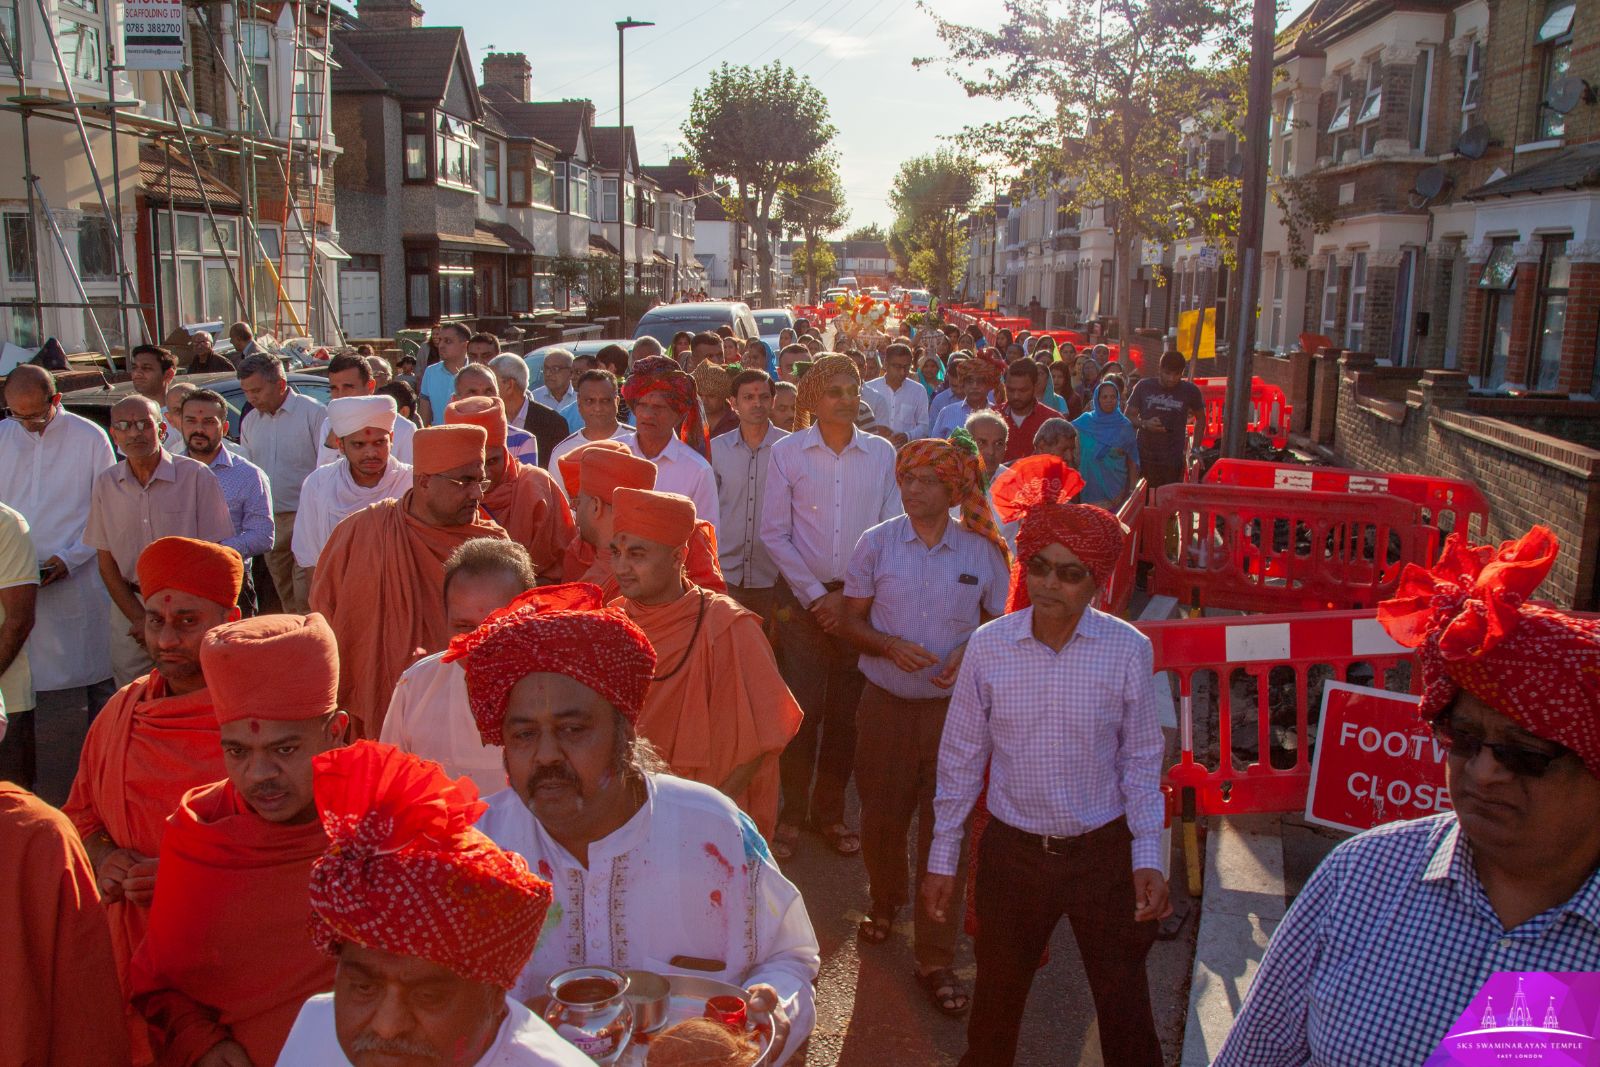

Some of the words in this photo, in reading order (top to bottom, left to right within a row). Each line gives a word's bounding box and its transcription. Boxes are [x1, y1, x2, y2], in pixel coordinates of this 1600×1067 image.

[126, 9, 168, 18] SCAFFOLDING
[170, 9, 181, 18] LTD
[126, 23, 145, 33] 0785
[147, 23, 181, 33] 3882700
